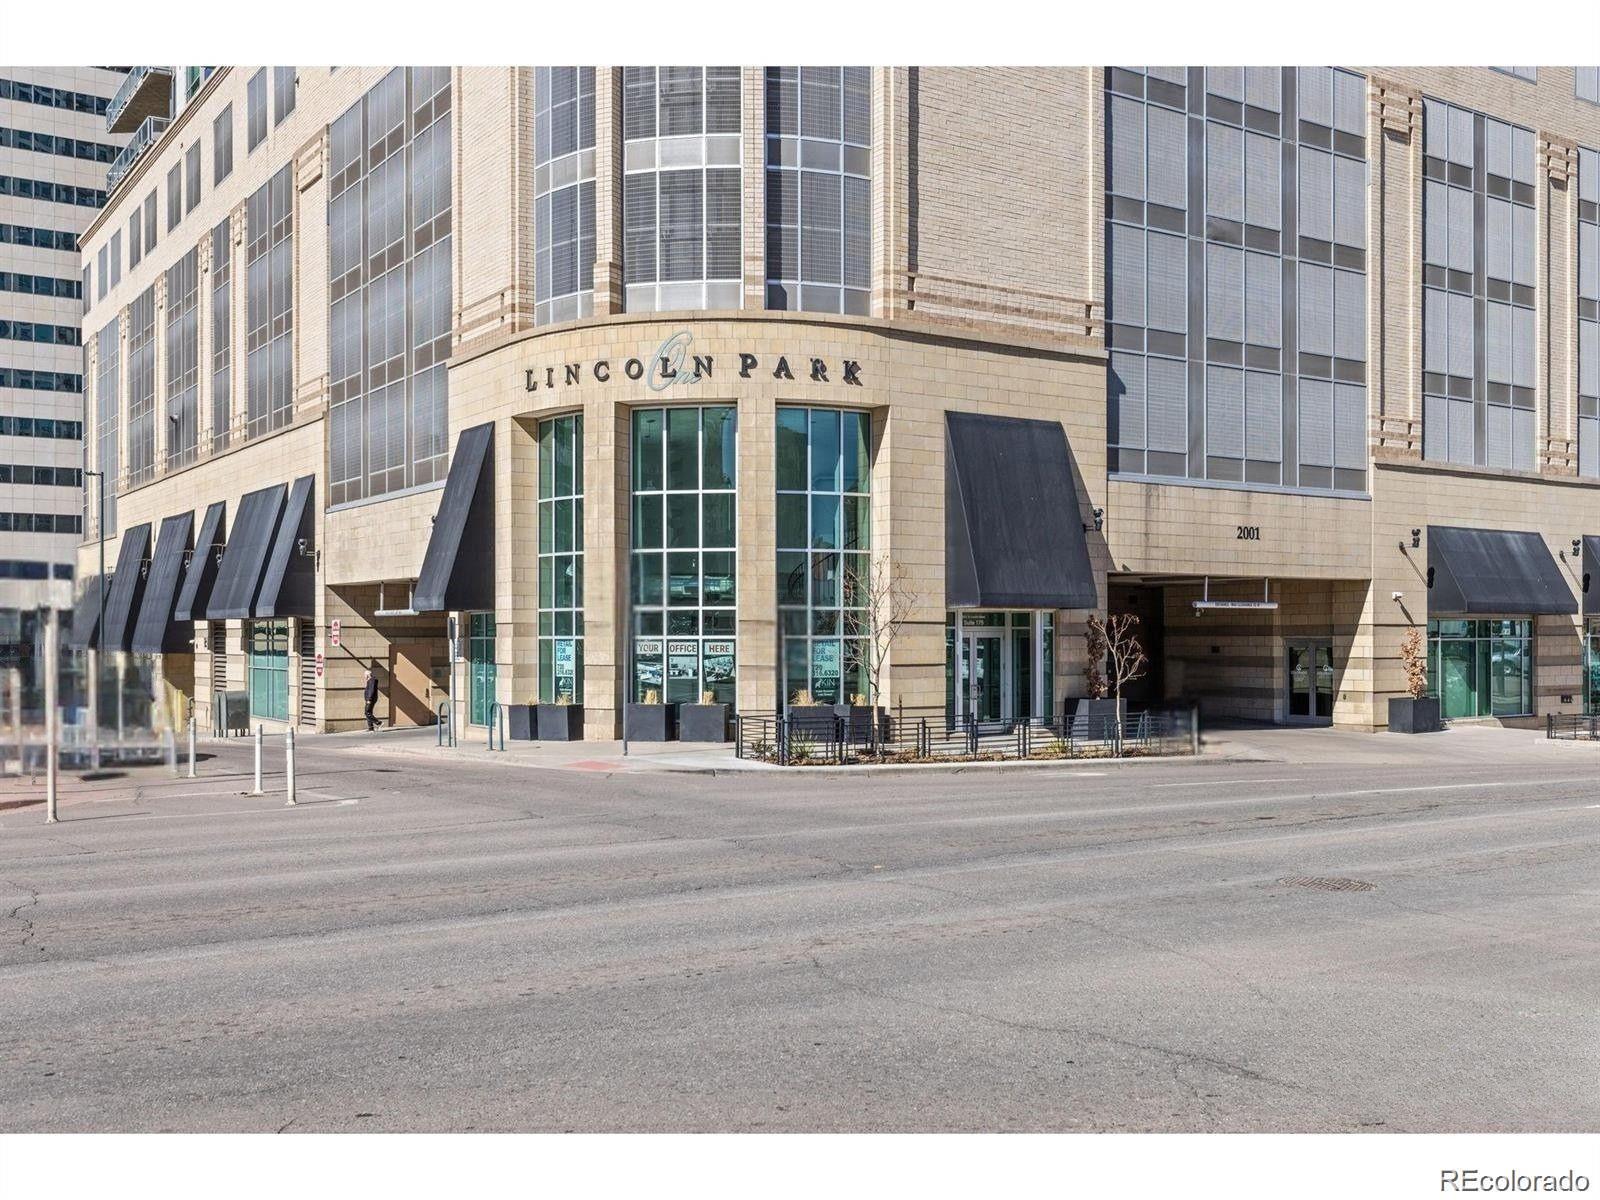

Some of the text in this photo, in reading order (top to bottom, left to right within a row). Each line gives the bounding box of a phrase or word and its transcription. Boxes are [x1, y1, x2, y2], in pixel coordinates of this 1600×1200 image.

[525, 353, 863, 392] LINCOLN PARK
[1237, 526, 1260, 540] 2001
[639, 644, 730, 653] YOUR OFFICE HERE
